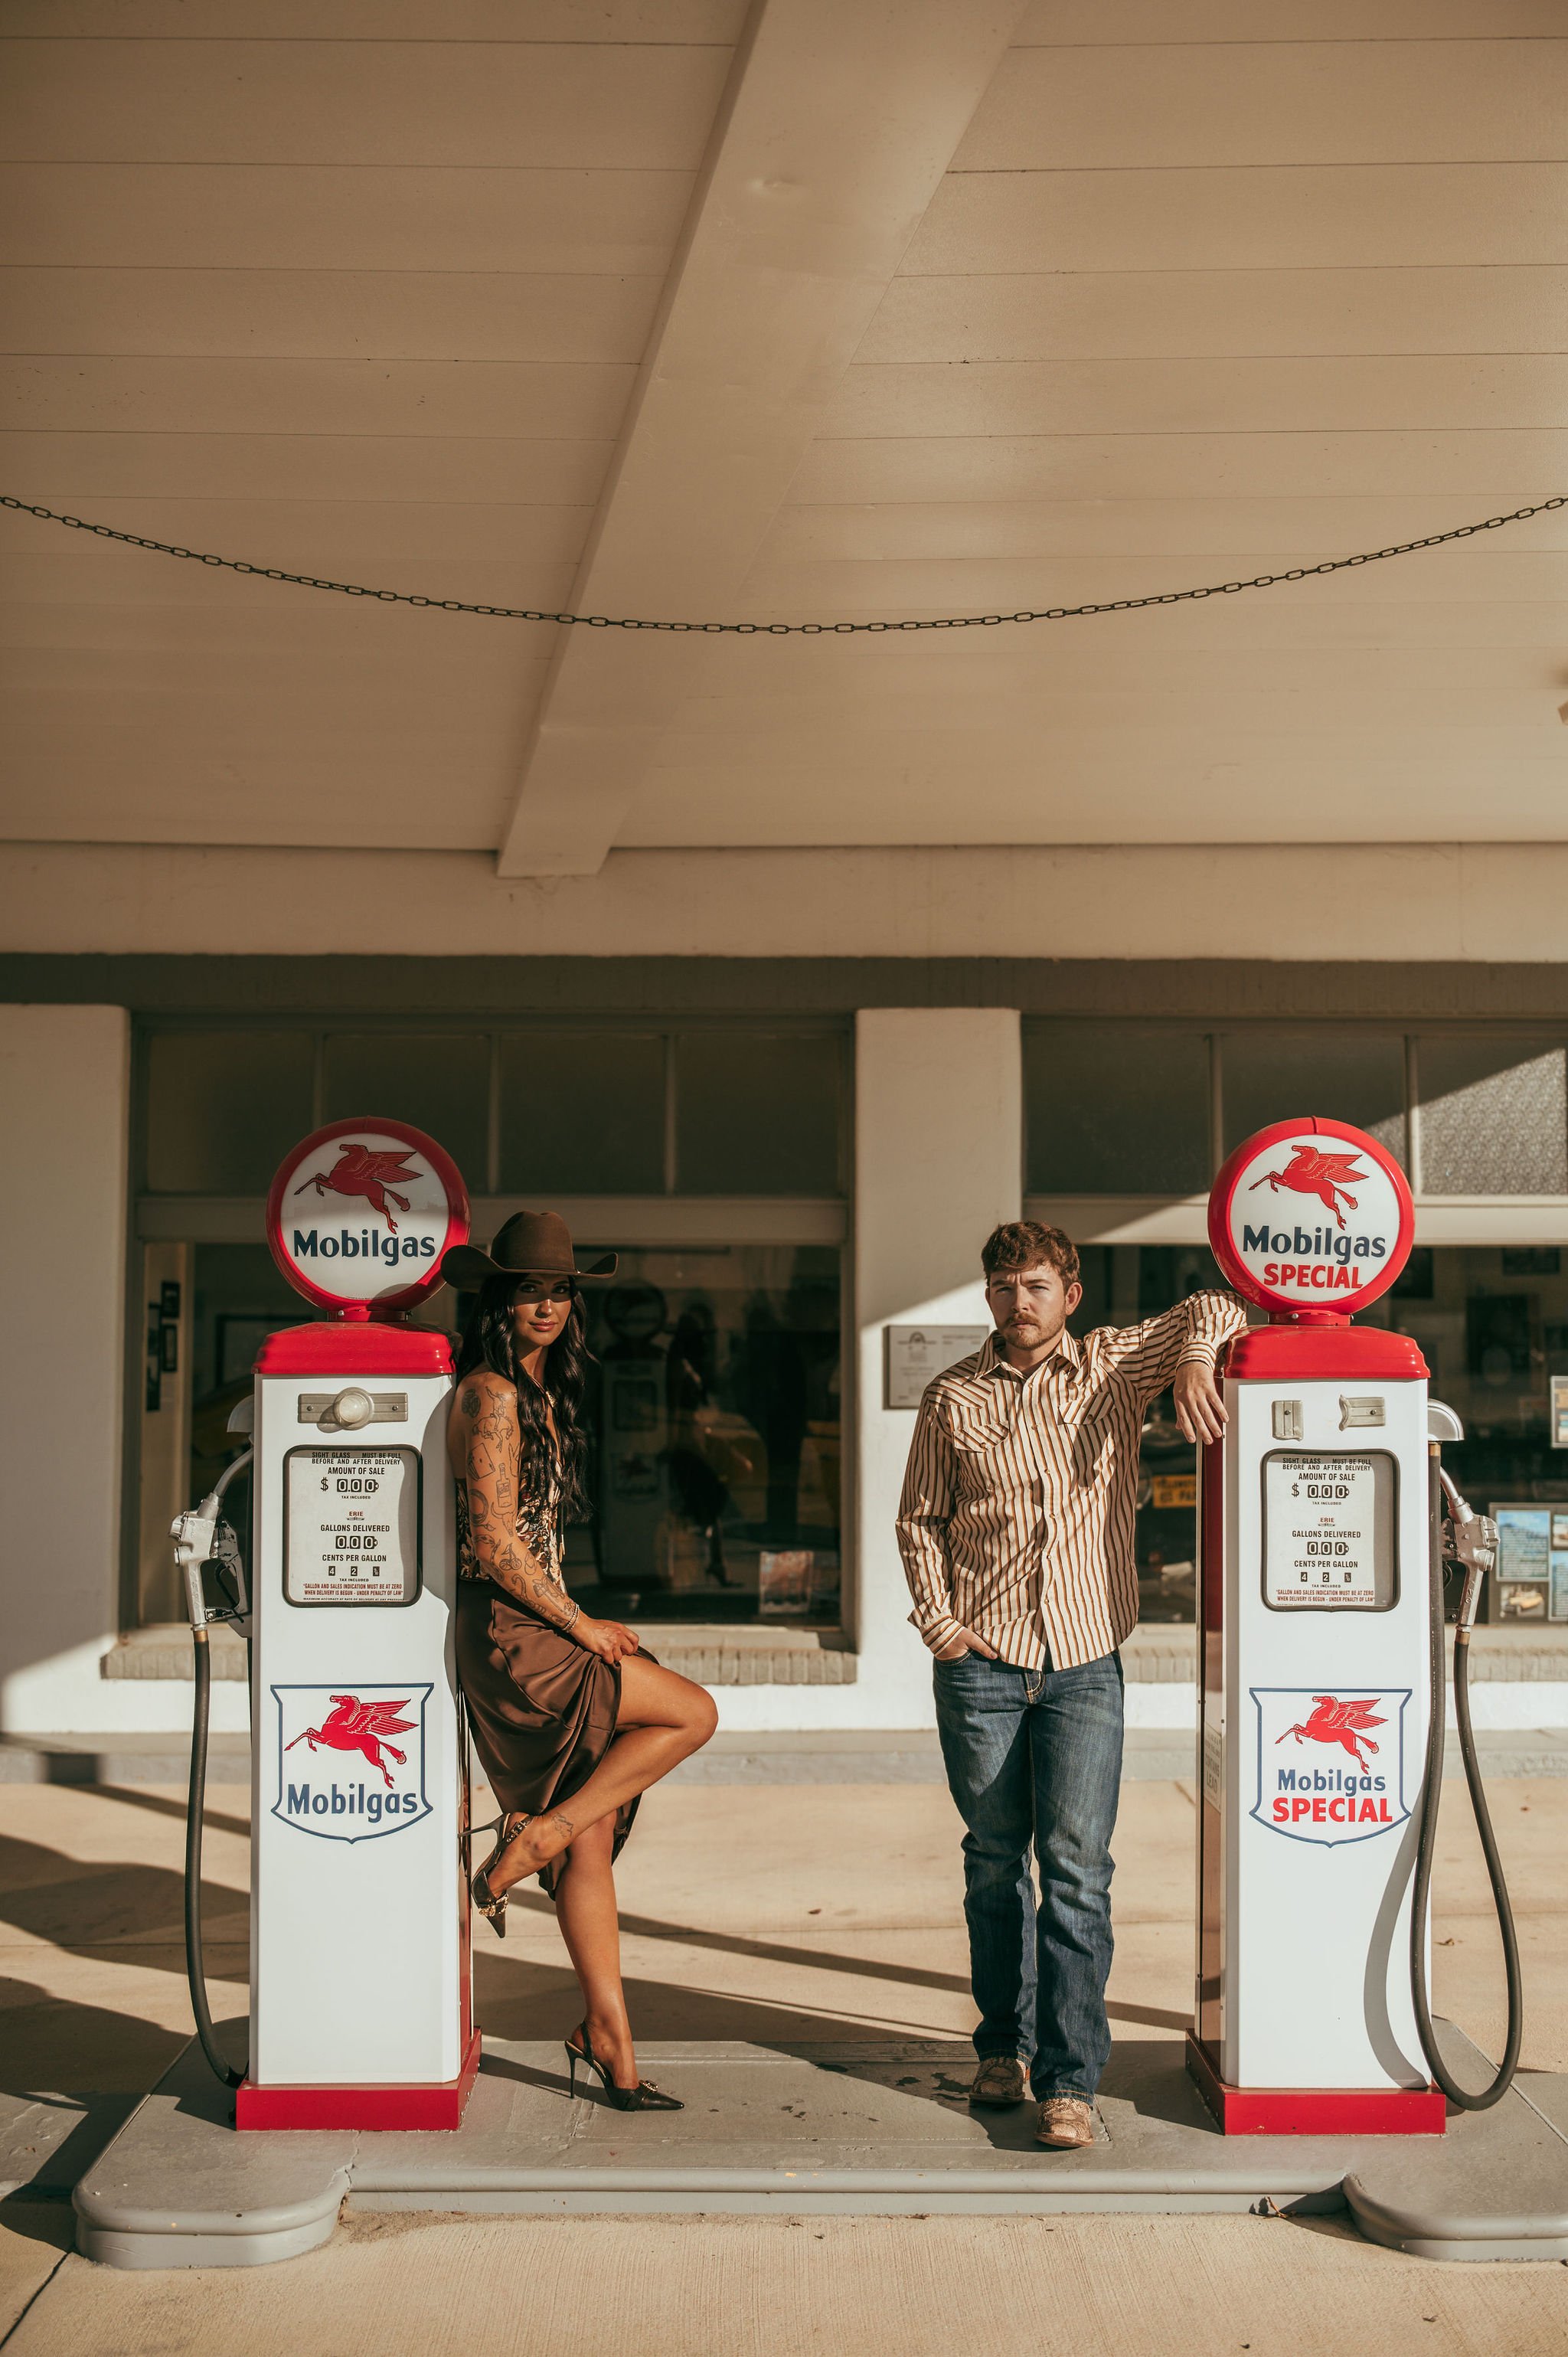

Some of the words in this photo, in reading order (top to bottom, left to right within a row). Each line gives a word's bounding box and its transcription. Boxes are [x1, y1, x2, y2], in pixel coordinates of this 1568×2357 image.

[293, 1229, 436, 1267] Mobilgas
[1243, 1224, 1386, 1265] Mobilgas
[1263, 1263, 1364, 1290] SPECIAL
[320, 1476, 328, 1492] $
[1291, 1483, 1299, 1498] $
[1207, 1770, 1218, 1793] LEAD
[1278, 1769, 1386, 1796] Mobilgas
[287, 1783, 418, 1823] Mobilgas
[1272, 1797, 1393, 1823] SPECIAL
